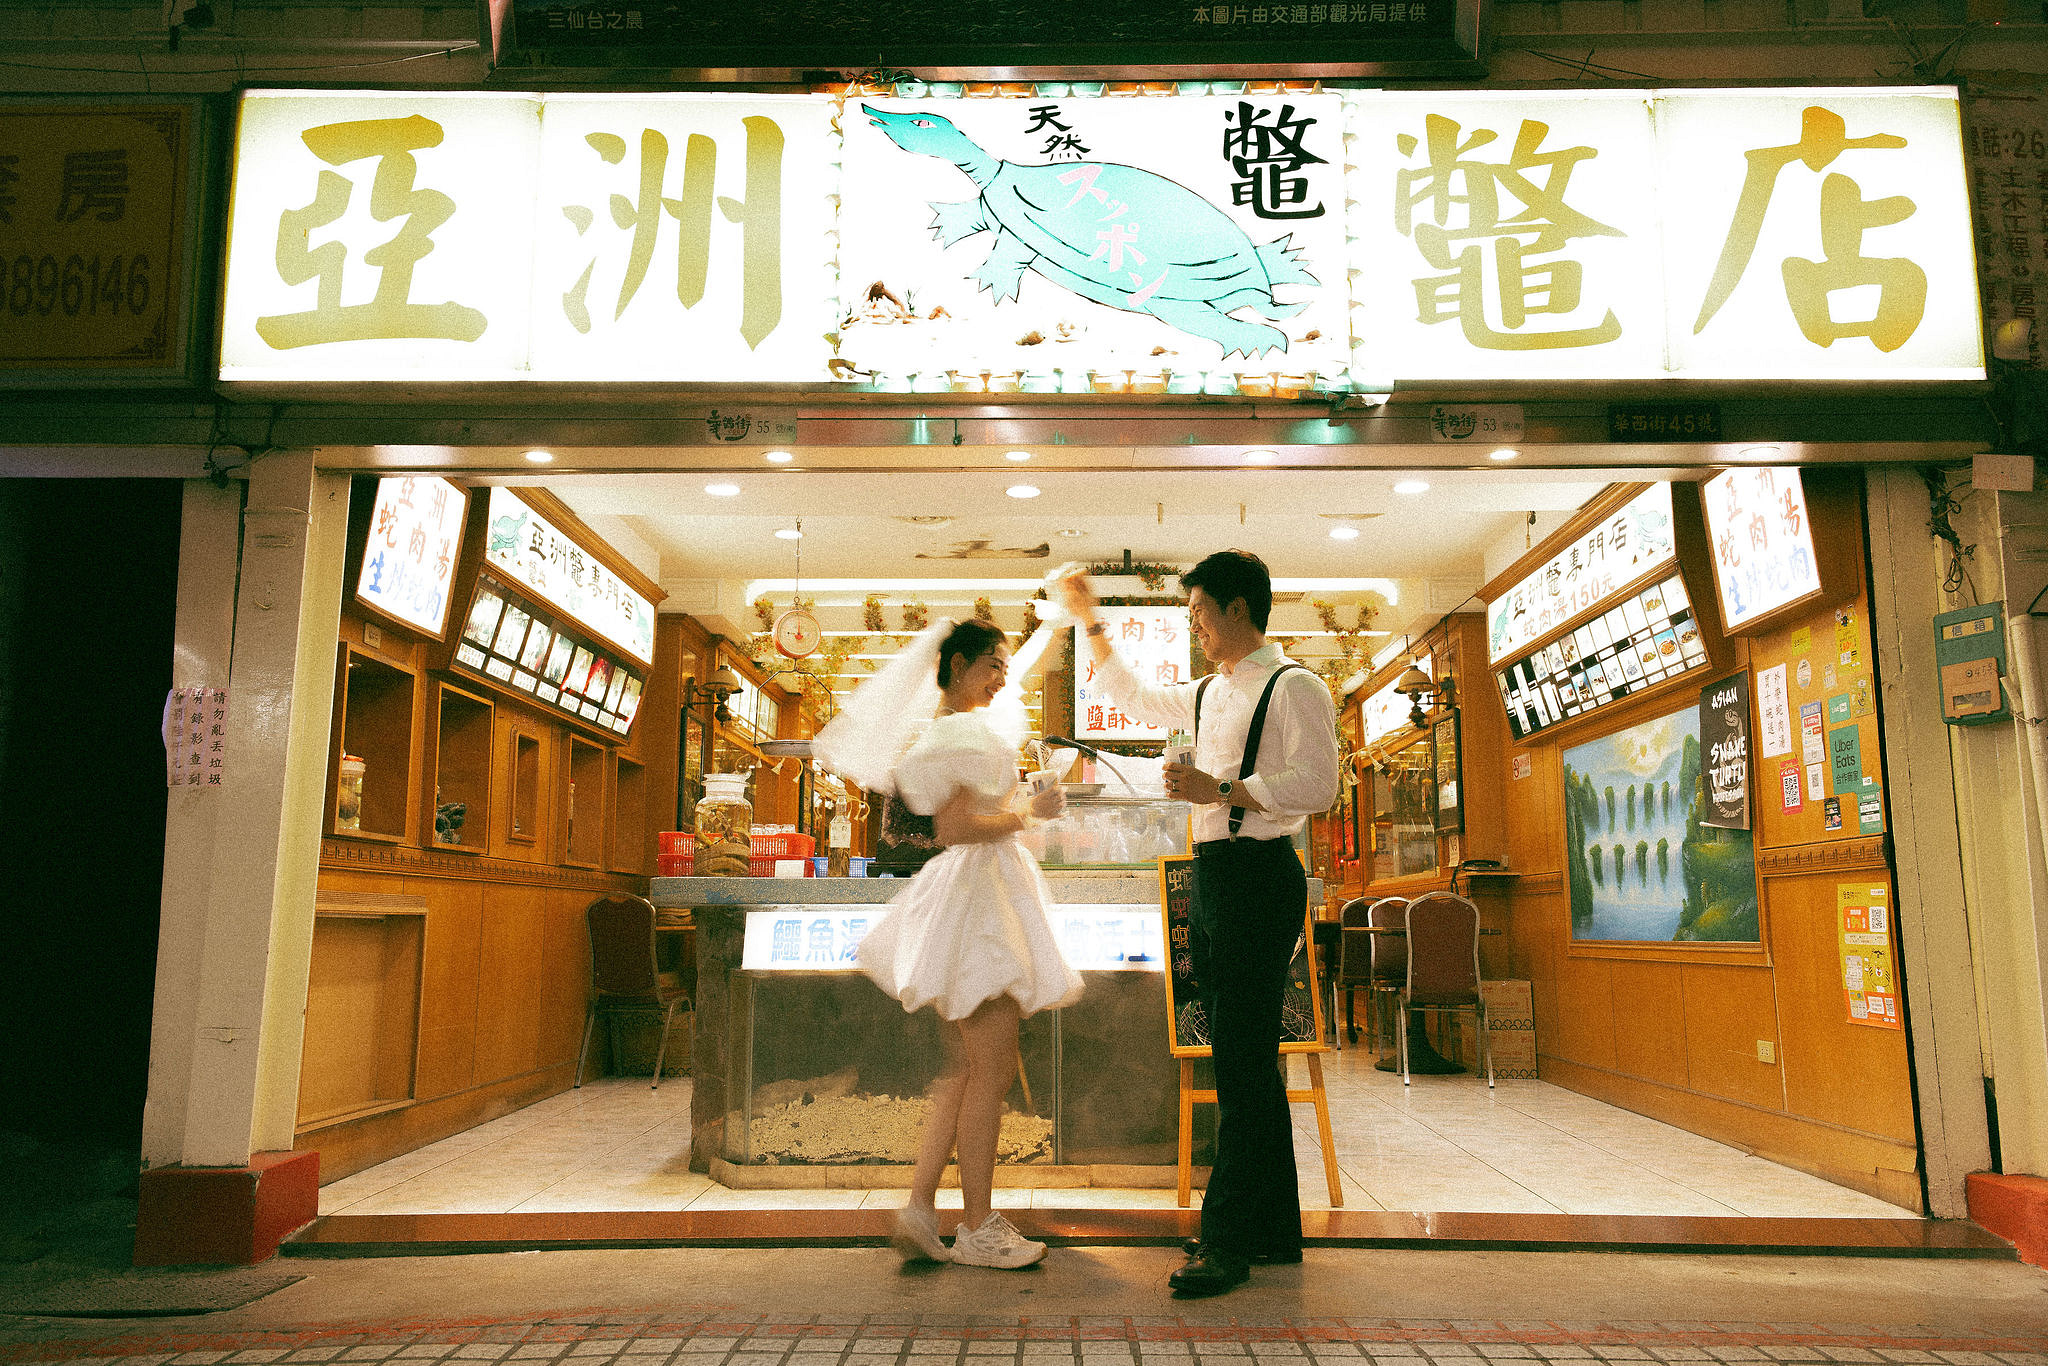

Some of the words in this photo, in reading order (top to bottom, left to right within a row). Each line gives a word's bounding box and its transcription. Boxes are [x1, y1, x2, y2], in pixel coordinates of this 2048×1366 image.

[1192, 3, 1428, 25] 本圖片由交通部觀光局提供
[1024, 105, 1091, 160] 天然
[0, 149, 129, 223] 房
[1057, 164, 1169, 309] スッポン
[0, 255, 150, 316] 896146
[756, 420, 770, 433] 55
[1483, 418, 1496, 431] 53
[377, 500, 451, 582] 蛇肉湯
[1719, 487, 1801, 568] 蛇肉湯
[1951, 619, 1986, 637] 信箱
[1711, 687, 1738, 709] ASIAN
[188, 691, 204, 786] 有錄影查到
[208, 692, 227, 786] 請勿亂丟垃圾
[1710, 735, 1746, 765] SNAKE
[1834, 740, 1853, 753] Uber
[1836, 754, 1855, 769] Eats
